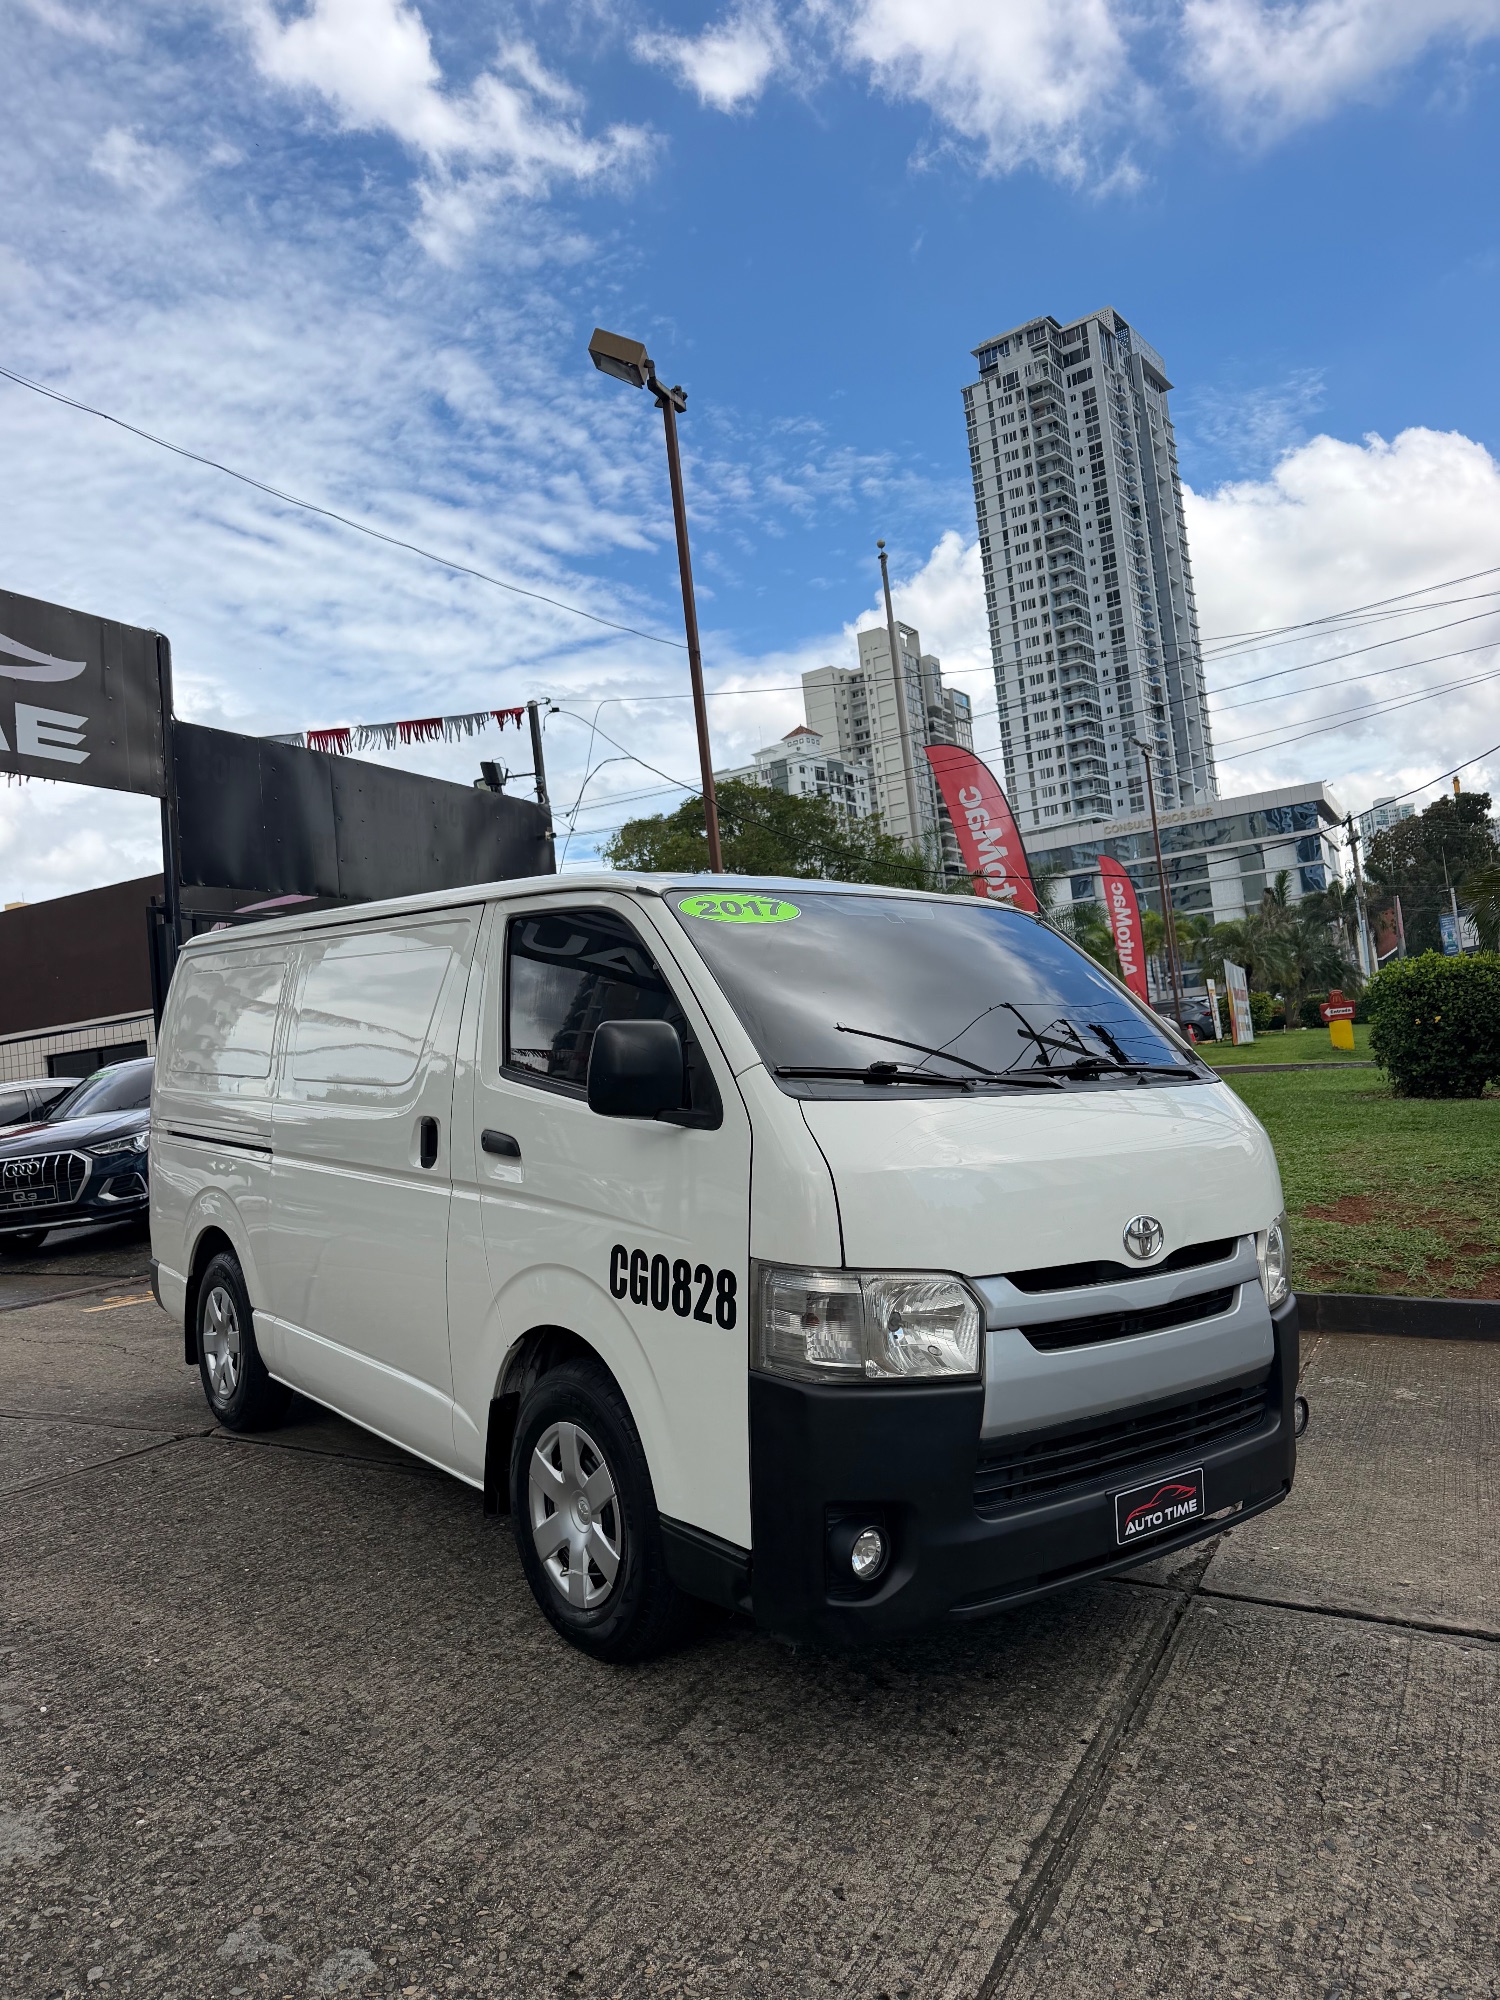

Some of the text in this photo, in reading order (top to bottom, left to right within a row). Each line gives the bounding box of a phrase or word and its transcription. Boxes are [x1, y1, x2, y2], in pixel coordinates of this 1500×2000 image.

[0, 702, 91, 764] E
[1104, 807, 1214, 835] CONSULTORIOS SUR
[695, 900, 782, 917] 2017
[12, 1191, 38, 1202] Q3
[609, 1244, 738, 1331] CG0828
[1125, 1499, 1198, 1535] AUTO TIME
